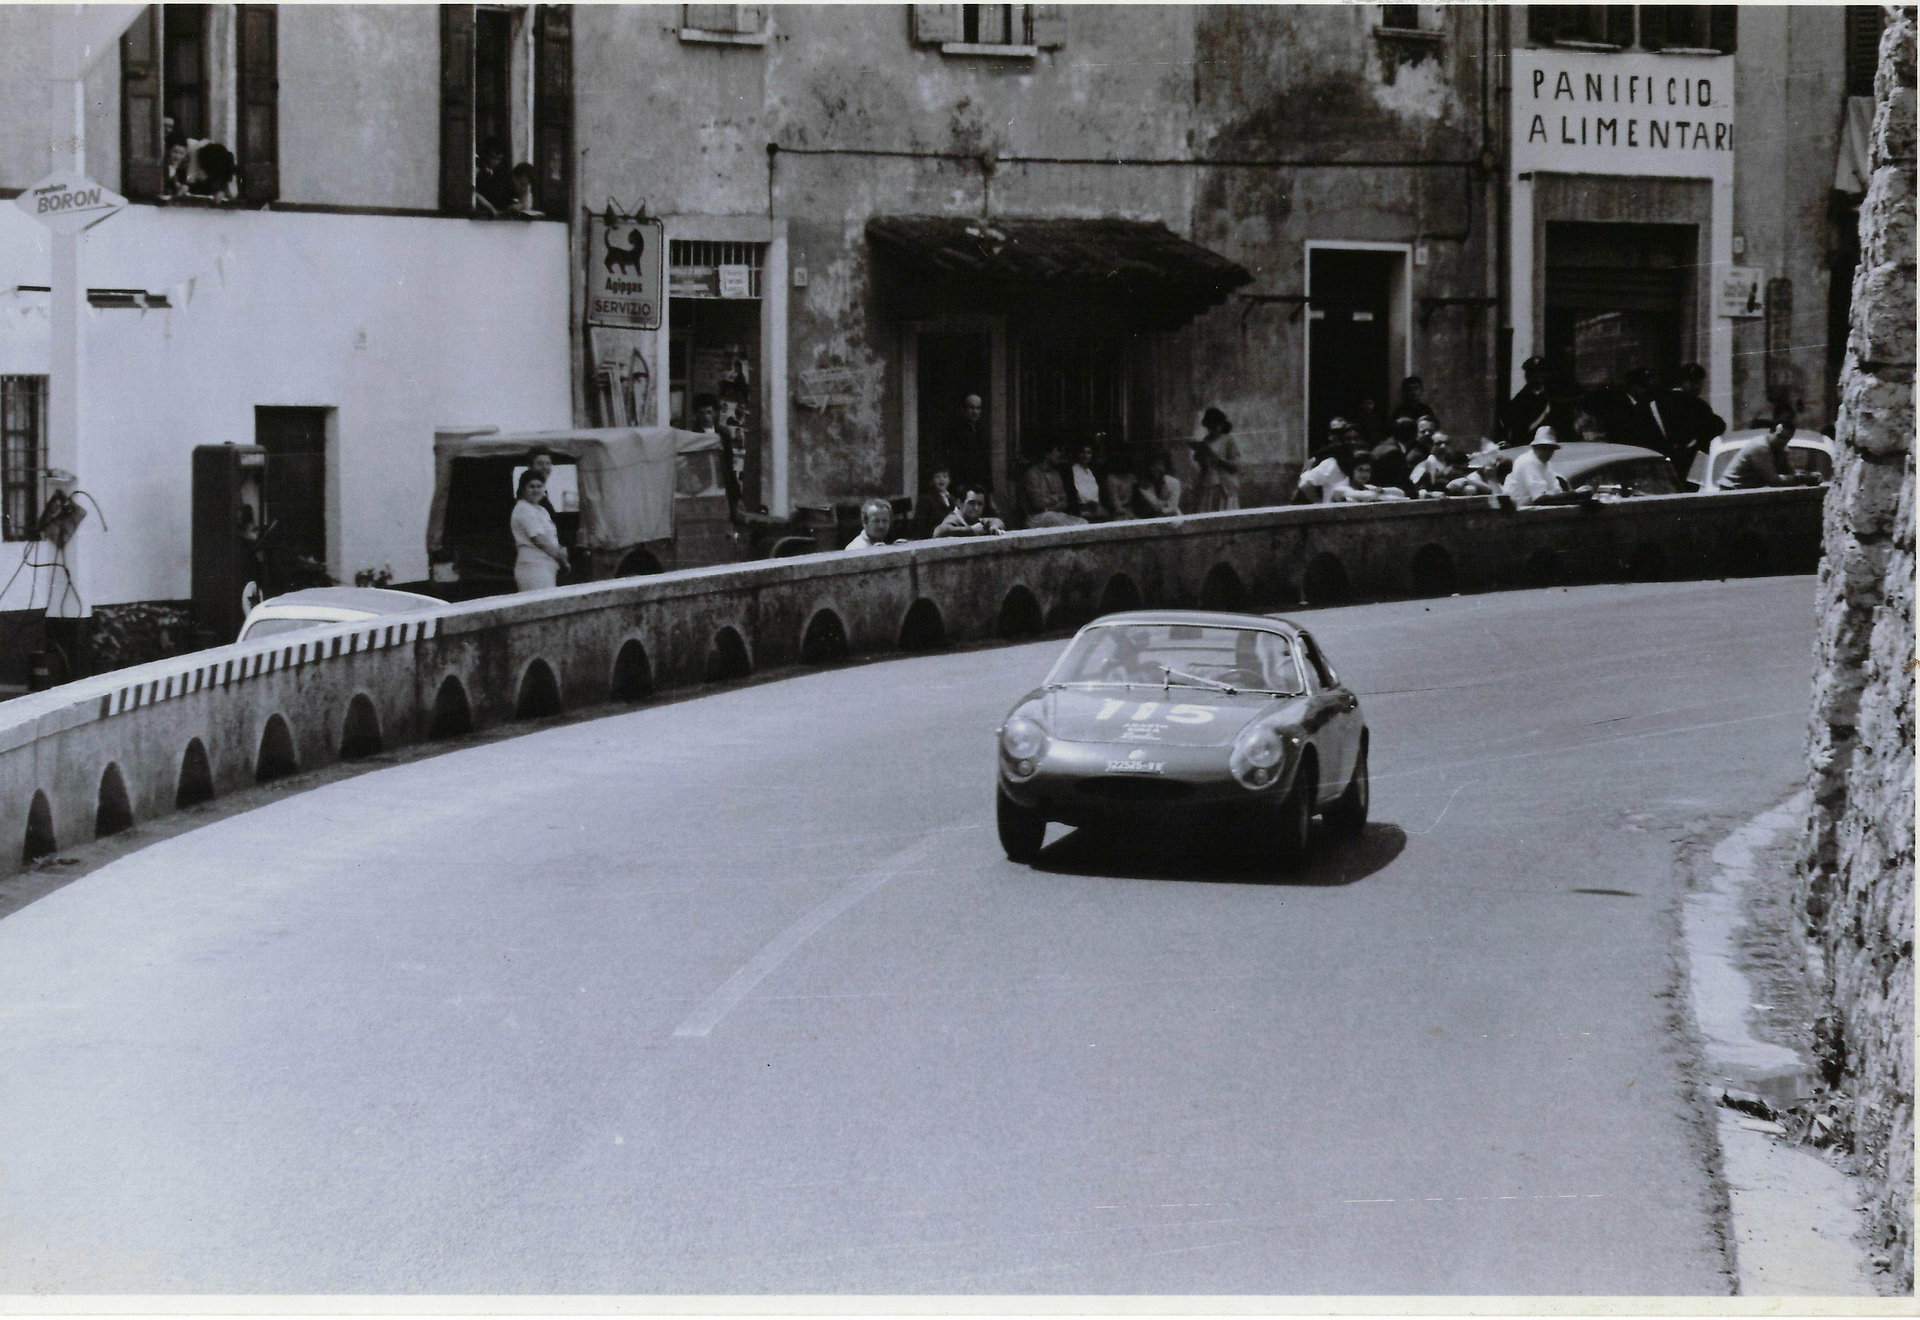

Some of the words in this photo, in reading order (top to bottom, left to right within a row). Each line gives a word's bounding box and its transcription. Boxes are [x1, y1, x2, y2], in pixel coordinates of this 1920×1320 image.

[1533, 69, 1711, 107] PANIFICIO
[1528, 114, 1733, 151] ALIMENTARI
[37, 188, 102, 214] BORON
[605, 277, 643, 295] Agipgas
[594, 299, 651, 316] SERVIZIO
[1096, 698, 1219, 724] 115
